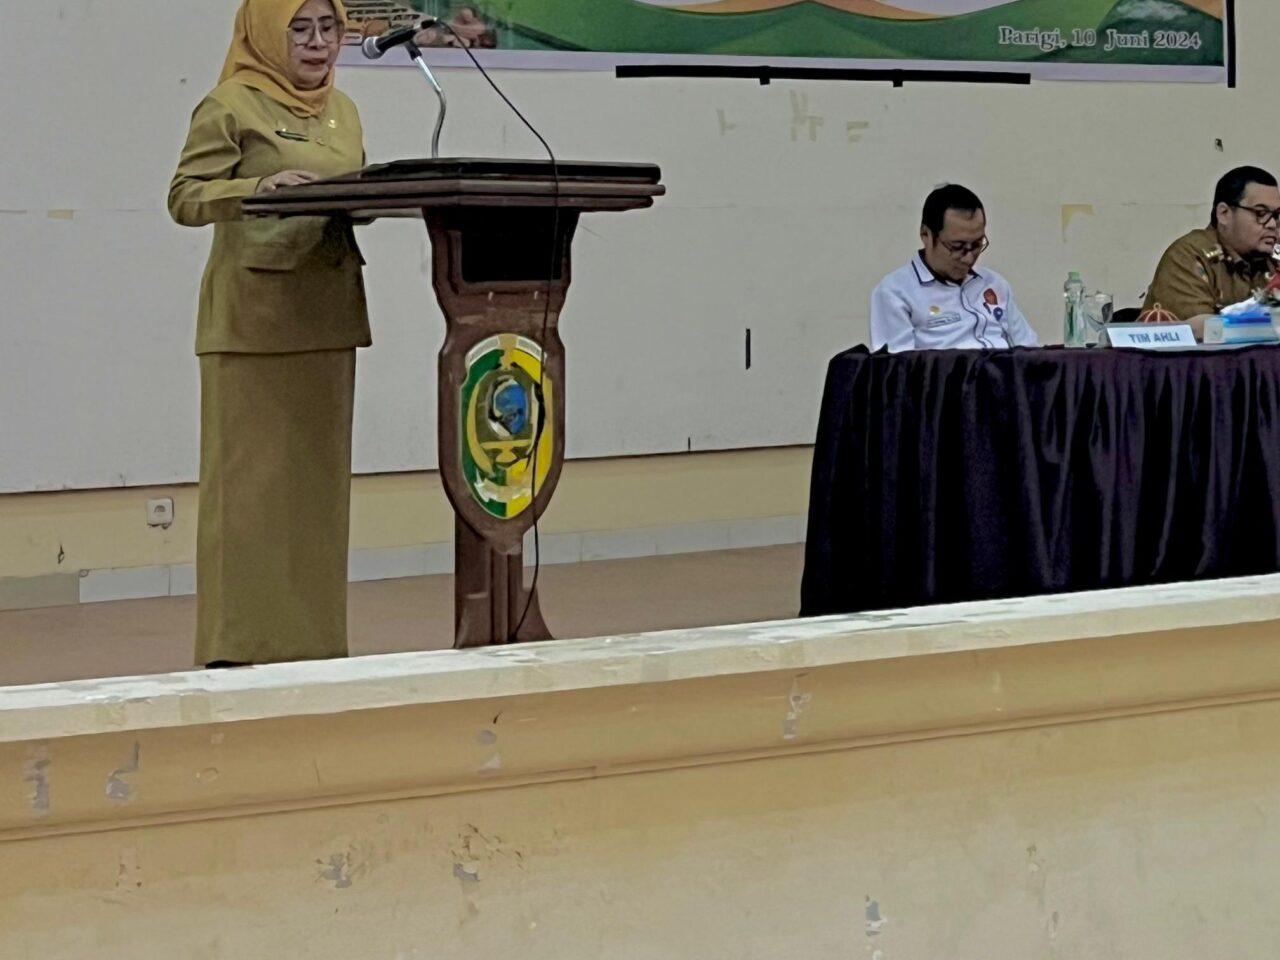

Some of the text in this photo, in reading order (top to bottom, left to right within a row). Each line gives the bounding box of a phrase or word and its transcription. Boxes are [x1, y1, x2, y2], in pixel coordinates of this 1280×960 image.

[999, 26, 1201, 52] Parigi, 10 Juni 2024
[1128, 333, 1151, 344] TIM
